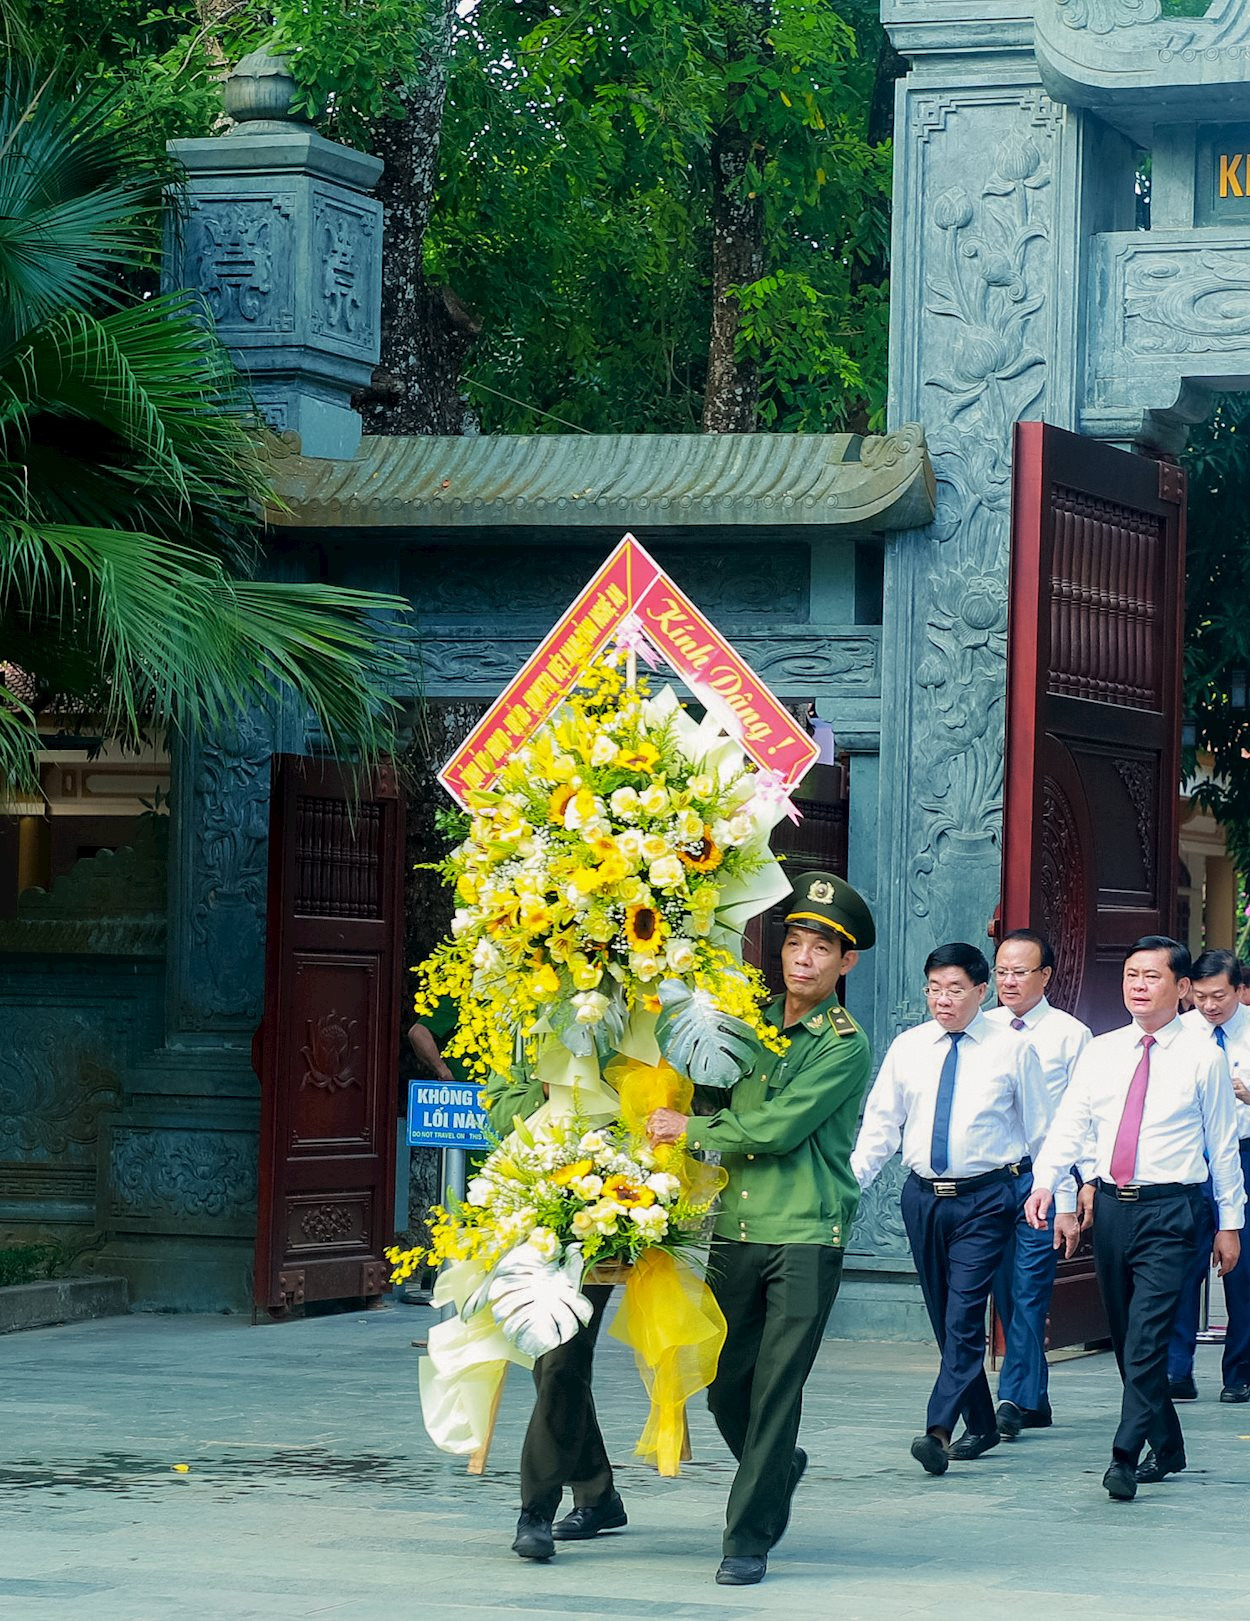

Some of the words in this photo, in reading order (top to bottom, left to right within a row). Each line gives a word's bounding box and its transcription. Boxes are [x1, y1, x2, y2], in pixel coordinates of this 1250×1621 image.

[646, 597, 715, 671] Kính
[708, 665, 773, 743] Dâng
[767, 735, 796, 755] !
[417, 1086, 473, 1106] KHÔNG
[423, 1107, 449, 1128] LỐI
[453, 1110, 486, 1129] NÀY
[421, 1131, 433, 1139] NOT
[434, 1132, 455, 1140] TRAVEL
